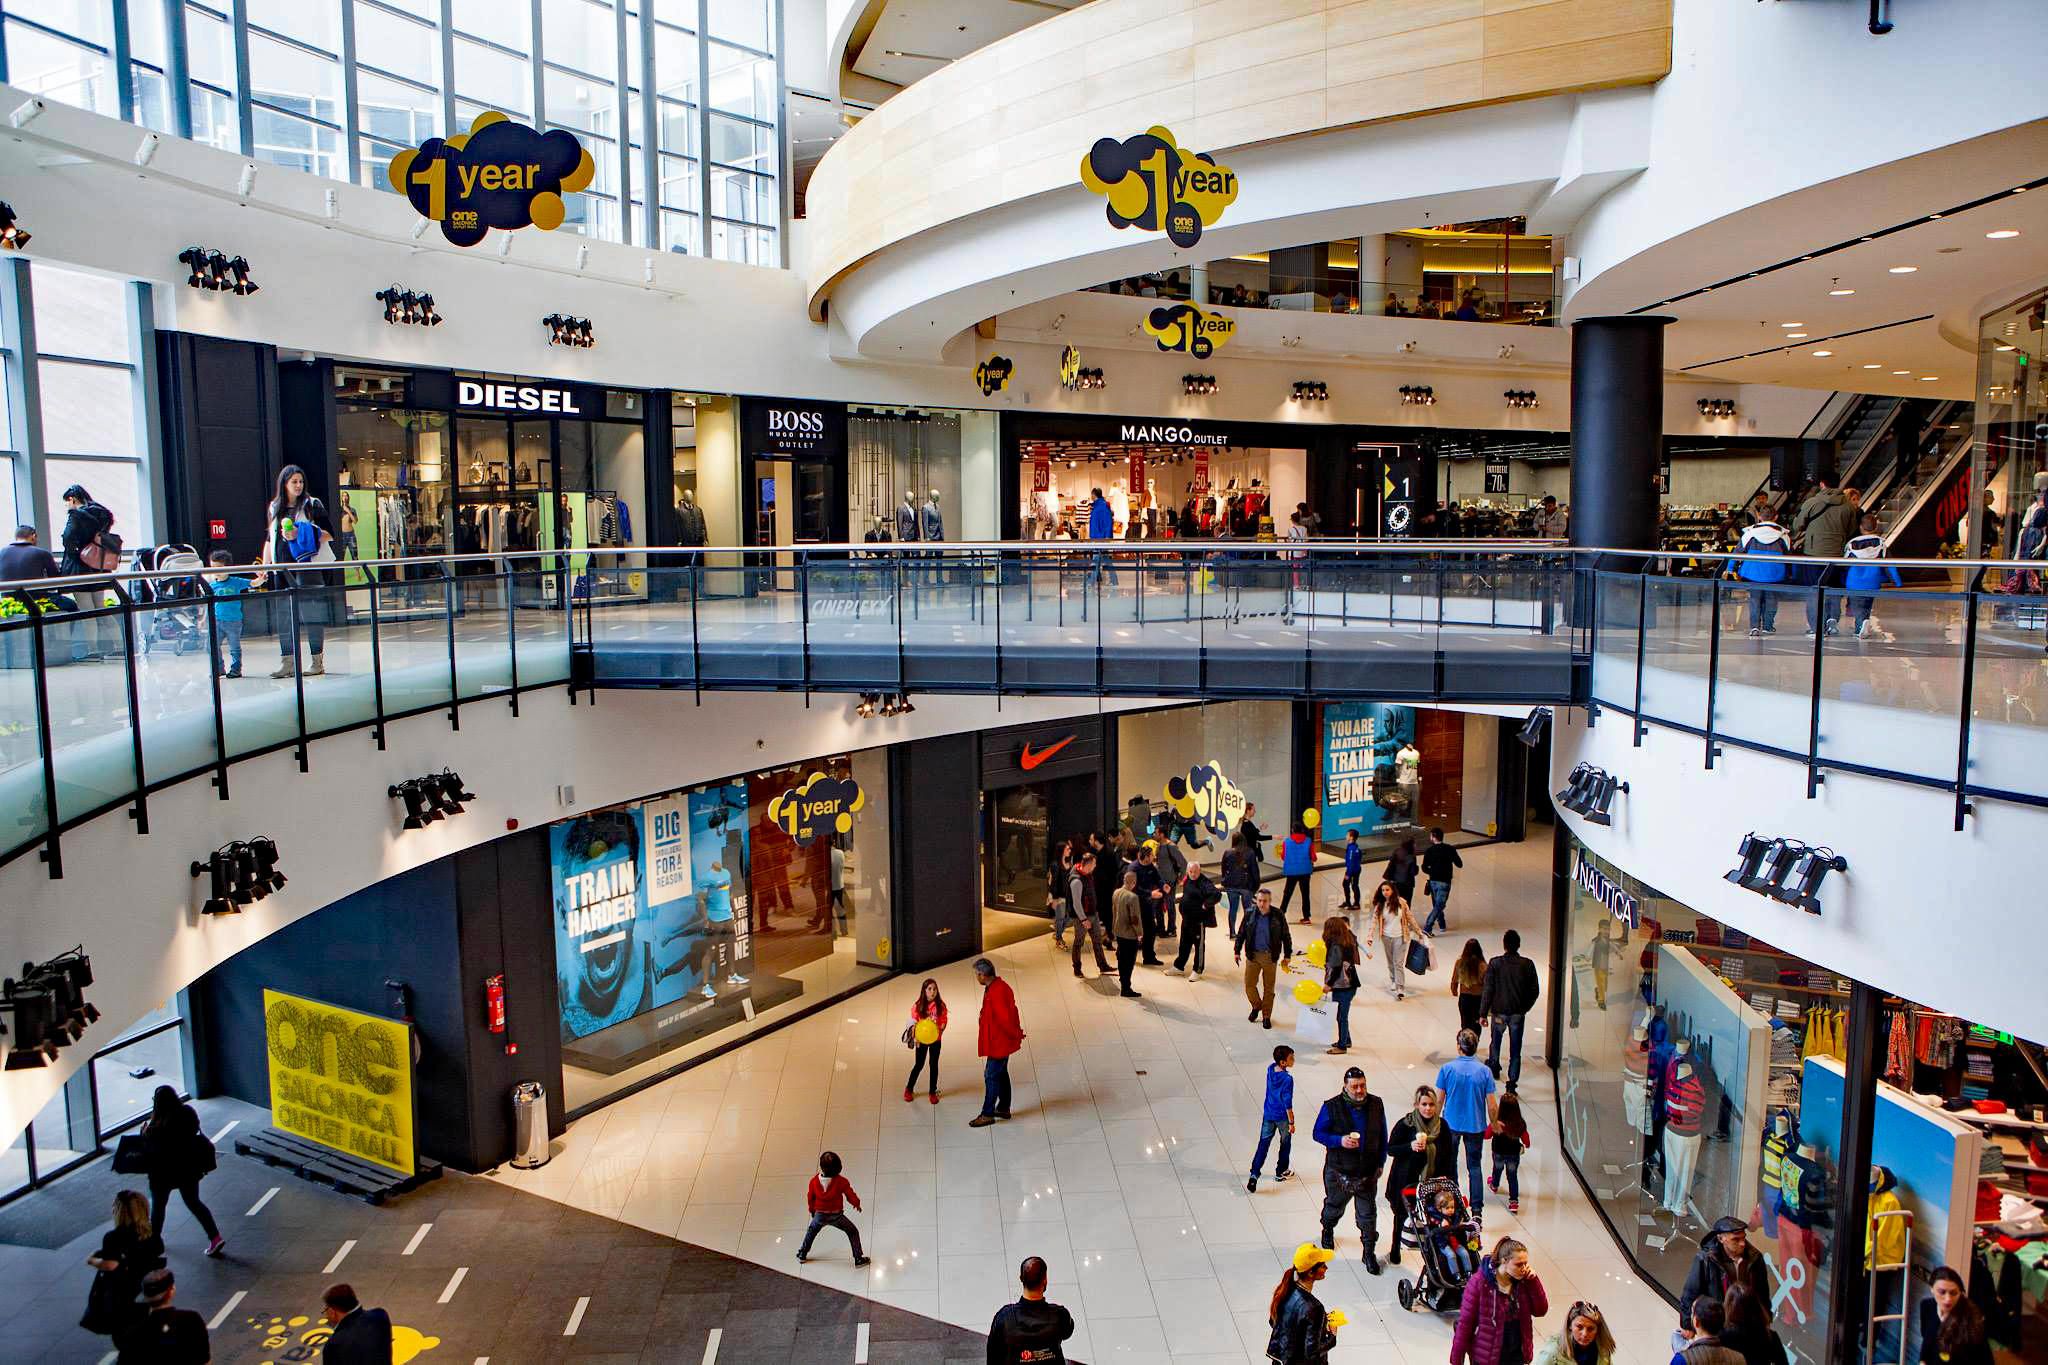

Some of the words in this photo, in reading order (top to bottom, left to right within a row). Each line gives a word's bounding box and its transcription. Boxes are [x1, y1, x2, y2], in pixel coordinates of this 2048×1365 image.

[412, 158, 446, 221] 1
[457, 163, 541, 199] year
[1140, 148, 1169, 232] 1
[1176, 170, 1235, 199] year
[452, 211, 478, 221] one
[1177, 311, 1194, 353] 1
[1198, 320, 1234, 336] year
[986, 369, 1005, 382] year
[458, 381, 580, 414] DIESEL
[768, 410, 824, 432] BOSS
[1121, 425, 1193, 443] MANGO
[1193, 434, 1228, 445] OUTLET
[779, 441, 815, 449] OUTLET
[799, 432, 824, 440] BOSS
[1402, 477, 1409, 498] 1
[811, 595, 893, 617] CINEPLEXX
[1330, 720, 1353, 738] YOU
[1353, 717, 1375, 736] ARE
[1330, 737, 1342, 751] AN
[1342, 735, 1375, 749] ATHLETE
[1330, 748, 1375, 773] TRAIN
[1205, 775, 1217, 828] 1
[1219, 790, 1243, 810] year
[1329, 779, 1340, 806] LIKE
[1340, 776, 1374, 805] ONE
[655, 810, 681, 841] BIG
[781, 800, 797, 835] 1
[802, 799, 841, 823] year
[657, 857, 676, 876] FOR
[657, 871, 684, 889] REASON
[565, 860, 635, 911] TRAIN
[1580, 861, 1633, 930] NAUTICA
[568, 894, 635, 938] HARDER
[266, 999, 399, 1096] one
[277, 1069, 400, 1138] SALONICA
[278, 1103, 346, 1146] OUTLET
[349, 1127, 400, 1166] MALL
